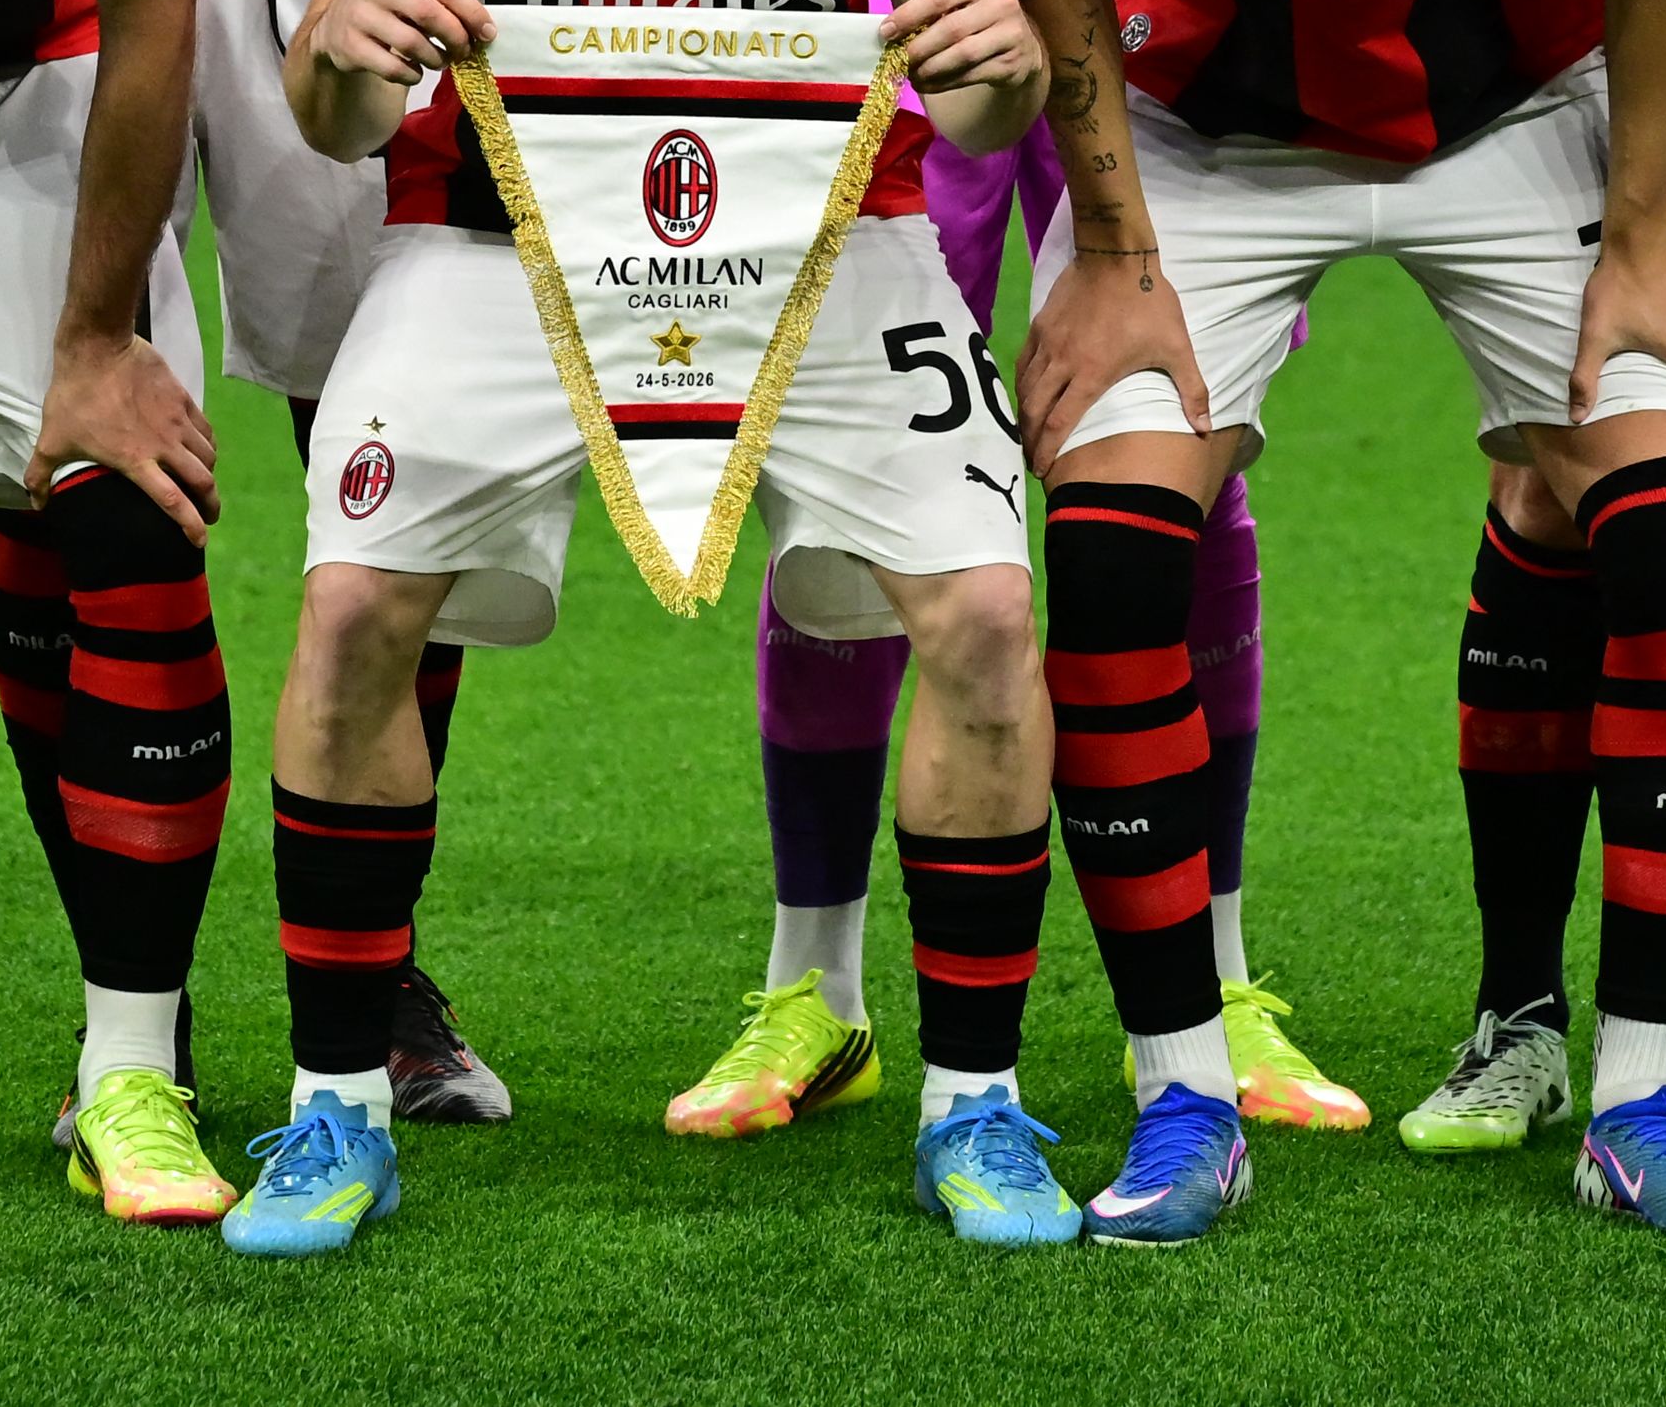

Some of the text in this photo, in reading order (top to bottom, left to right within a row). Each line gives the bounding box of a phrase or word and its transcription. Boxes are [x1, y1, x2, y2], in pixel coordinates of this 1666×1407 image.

[549, 25, 819, 60] CAMPIONATO
[662, 140, 701, 161] ACM
[1093, 152, 1117, 173] 33
[662, 216, 698, 233] 1899
[595, 257, 764, 286] AC MILAN
[628, 293, 729, 309] CAGLIARI
[635, 372, 715, 388] 24-5-2026
[881, 321, 1022, 445] 56
[356, 448, 385, 464] ACM
[349, 500, 373, 510] 1899
